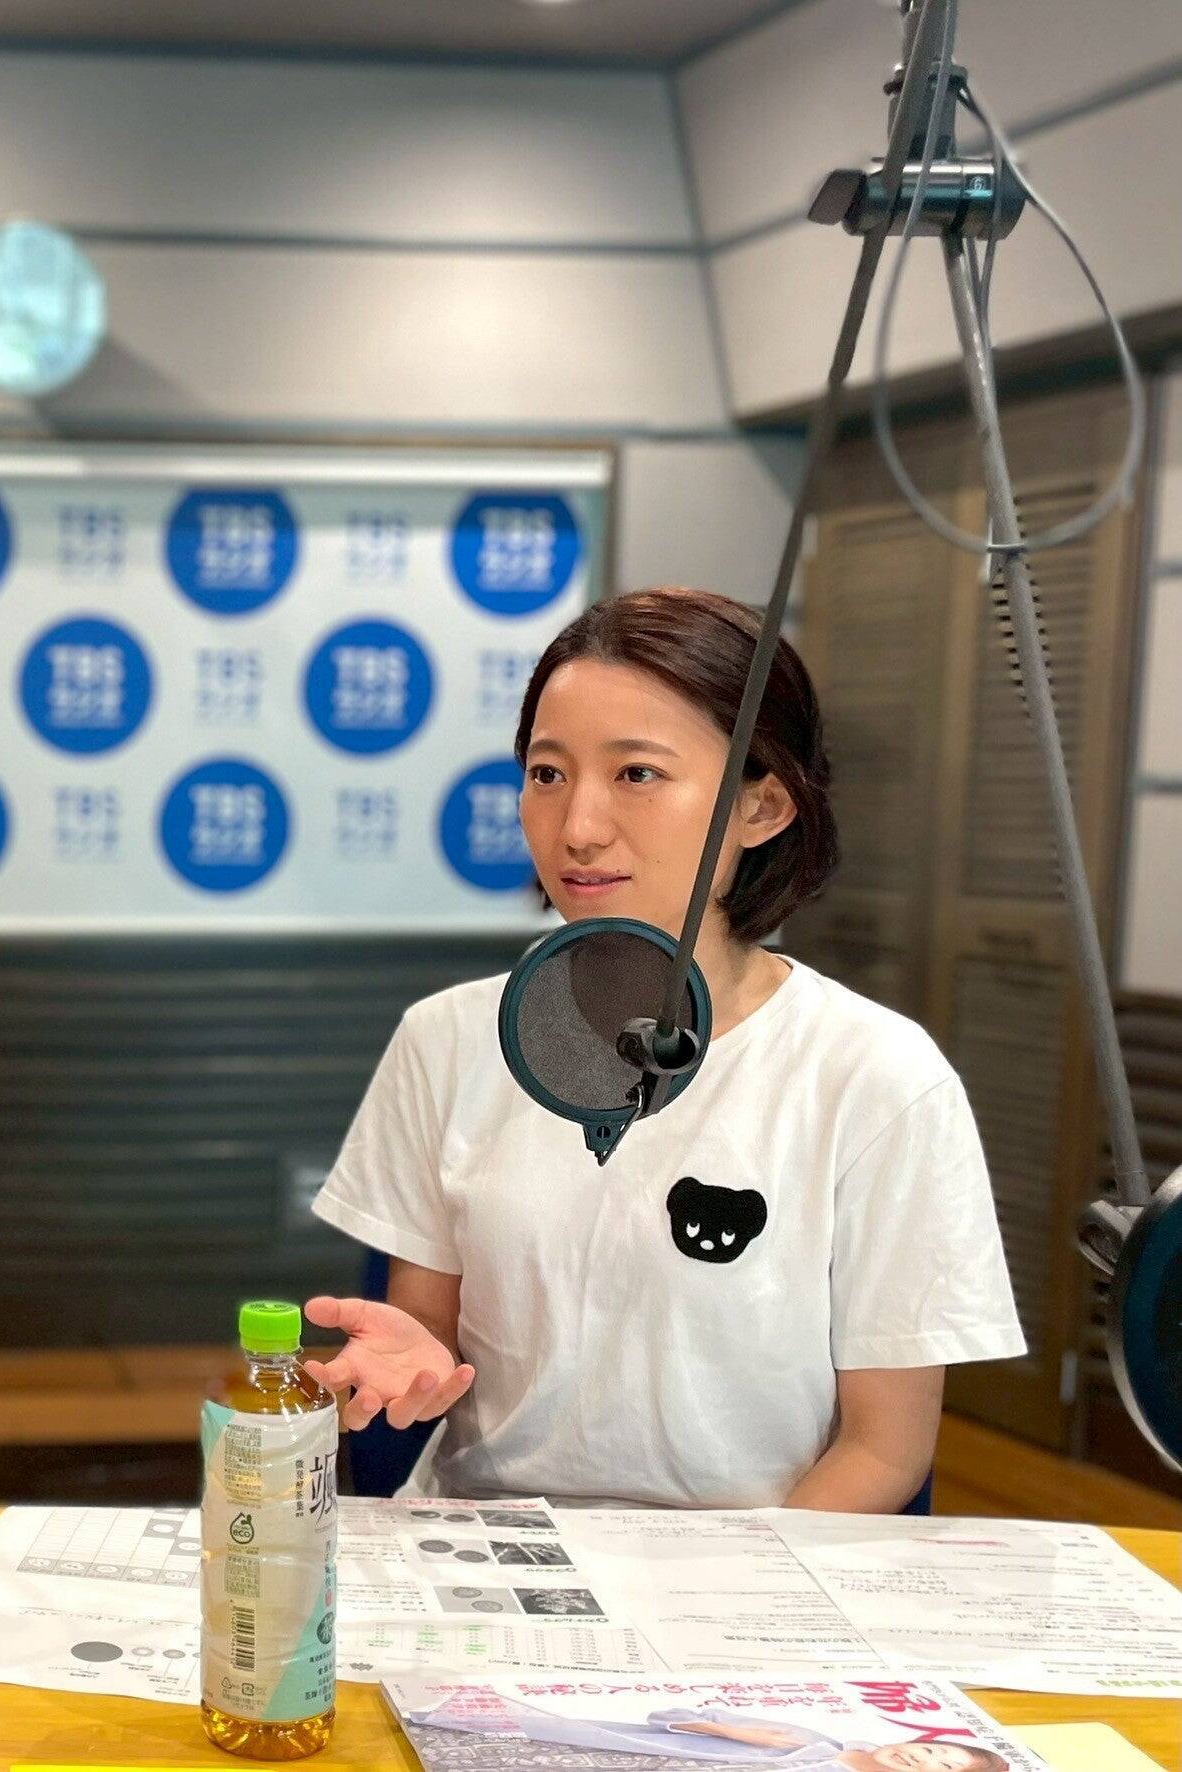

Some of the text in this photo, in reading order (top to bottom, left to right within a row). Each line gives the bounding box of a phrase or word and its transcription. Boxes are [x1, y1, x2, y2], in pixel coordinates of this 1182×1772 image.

[57, 503, 127, 538] TBS
[197, 504, 274, 541] TBS
[343, 508, 409, 541] TBS
[479, 507, 557, 546] TBS
[45, 644, 125, 684] TBS
[196, 649, 264, 685] TBS
[330, 645, 409, 684] TBS
[54, 785, 123, 821] TBS
[189, 784, 267, 823] TBS
[336, 787, 398, 823] TBS
